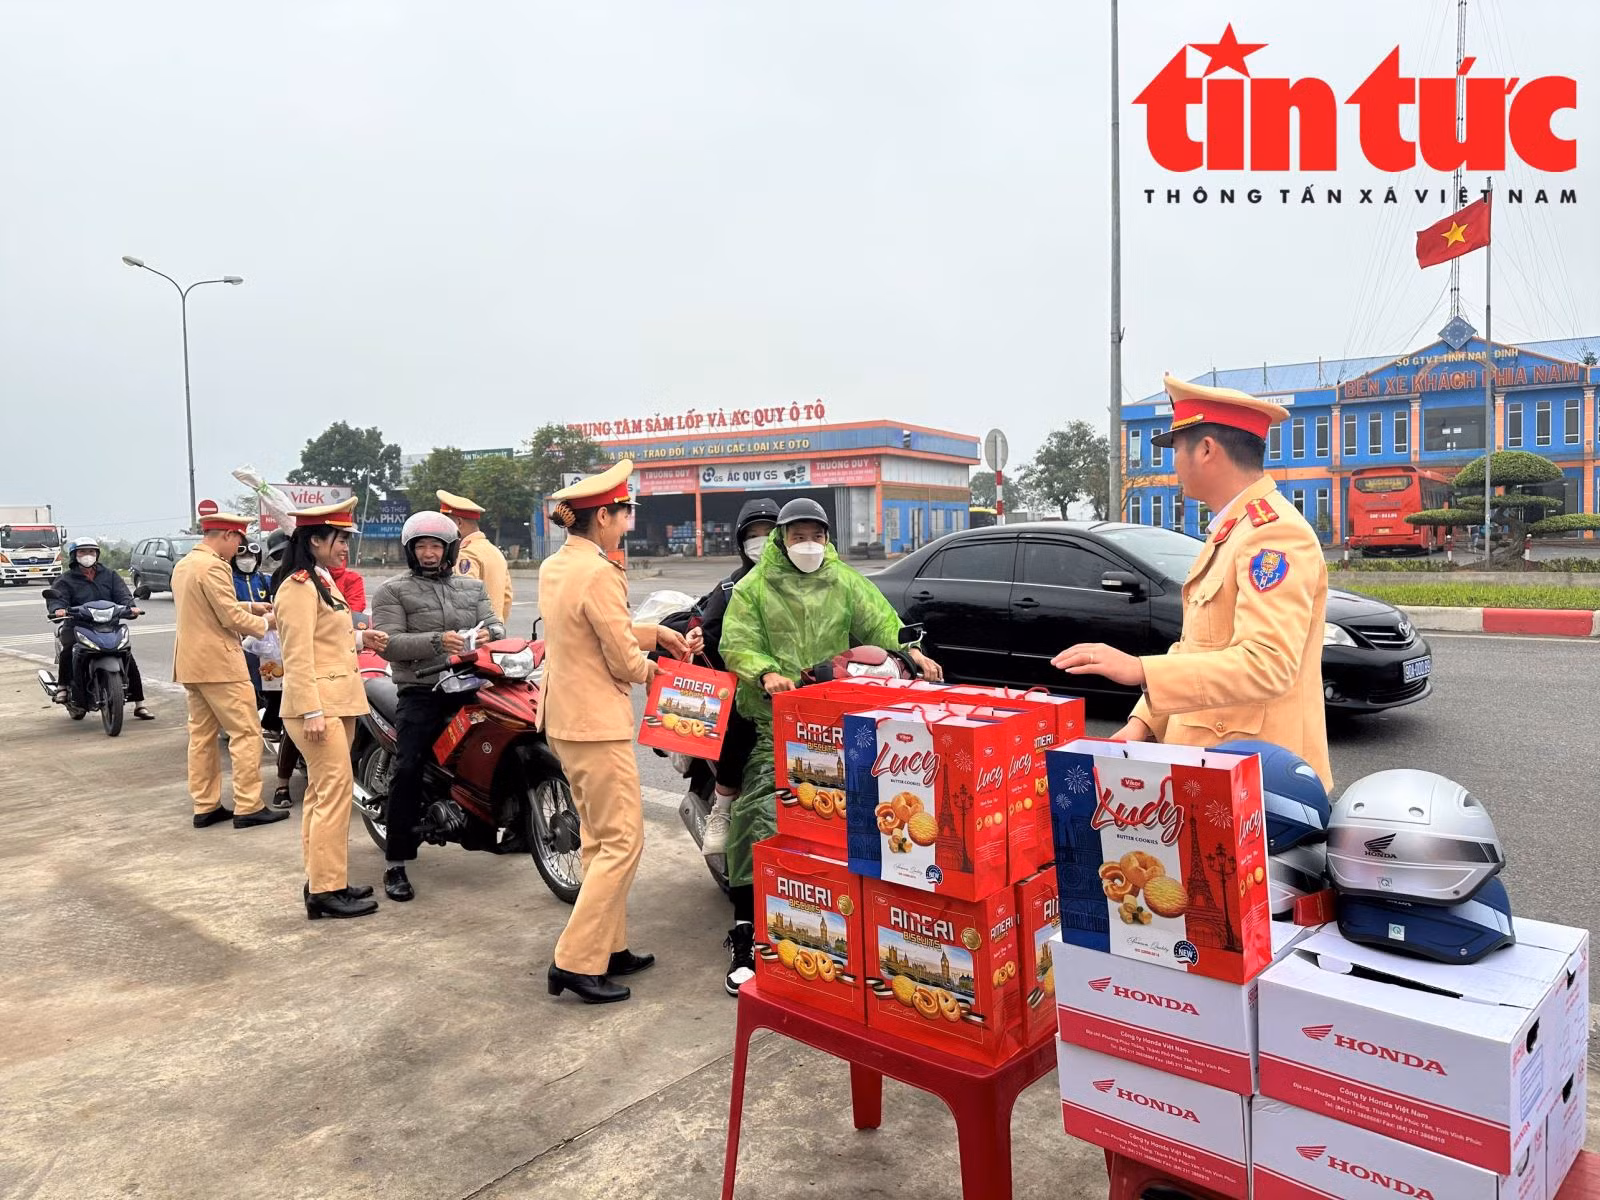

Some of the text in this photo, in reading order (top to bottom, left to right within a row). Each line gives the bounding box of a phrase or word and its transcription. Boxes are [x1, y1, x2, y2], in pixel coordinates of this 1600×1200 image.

[1412, 355, 1440, 365] GTVT
[1384, 375, 1409, 395] XE
[1411, 366, 1476, 392] KHÁCH
[1533, 363, 1580, 384] NAM
[614, 418, 642, 435] TÂM
[677, 408, 703, 429] LỐP
[707, 407, 727, 427] VÀ
[753, 406, 785, 426] QUY
[789, 400, 800, 421] Ô
[804, 398, 825, 420] TÔ
[643, 448, 667, 459] TRAO
[772, 440, 785, 450] XE
[742, 470, 760, 483] QUY
[763, 470, 778, 480] GS
[290, 489, 325, 504] Vitek
[673, 676, 716, 695] AMERI
[796, 721, 844, 745] AMER
[1034, 734, 1054, 748] MERI
[871, 742, 940, 788] Lucy
[976, 765, 1004, 792] Lucy
[1008, 753, 1032, 780] Lucy
[1091, 787, 1184, 847] Lucy
[1238, 809, 1262, 847] Lucy
[1116, 833, 1158, 845] BUTTER COOKIES
[1364, 850, 1398, 859] HONDA
[777, 876, 832, 908] AMERI
[890, 906, 955, 941] AMERI
[990, 915, 1014, 940] AMERI
[903, 931, 942, 951] BISCUITS
[1178, 947, 1193, 958] NEW
[1112, 985, 1200, 1016] HONDA
[1121, 1031, 1135, 1040] Công
[1143, 1038, 1161, 1046] Honda
[1175, 1046, 1188, 1054] Nam
[1333, 1033, 1448, 1076] HONDA
[1116, 1087, 1201, 1124] HONDA
[1339, 1087, 1428, 1119] Công ty Honda Việt Nam
[1129, 1133, 1143, 1143] Công
[1151, 1141, 1169, 1151] Honda
[1183, 1152, 1196, 1160] Nam
[1327, 1155, 1437, 1200] HONDA
